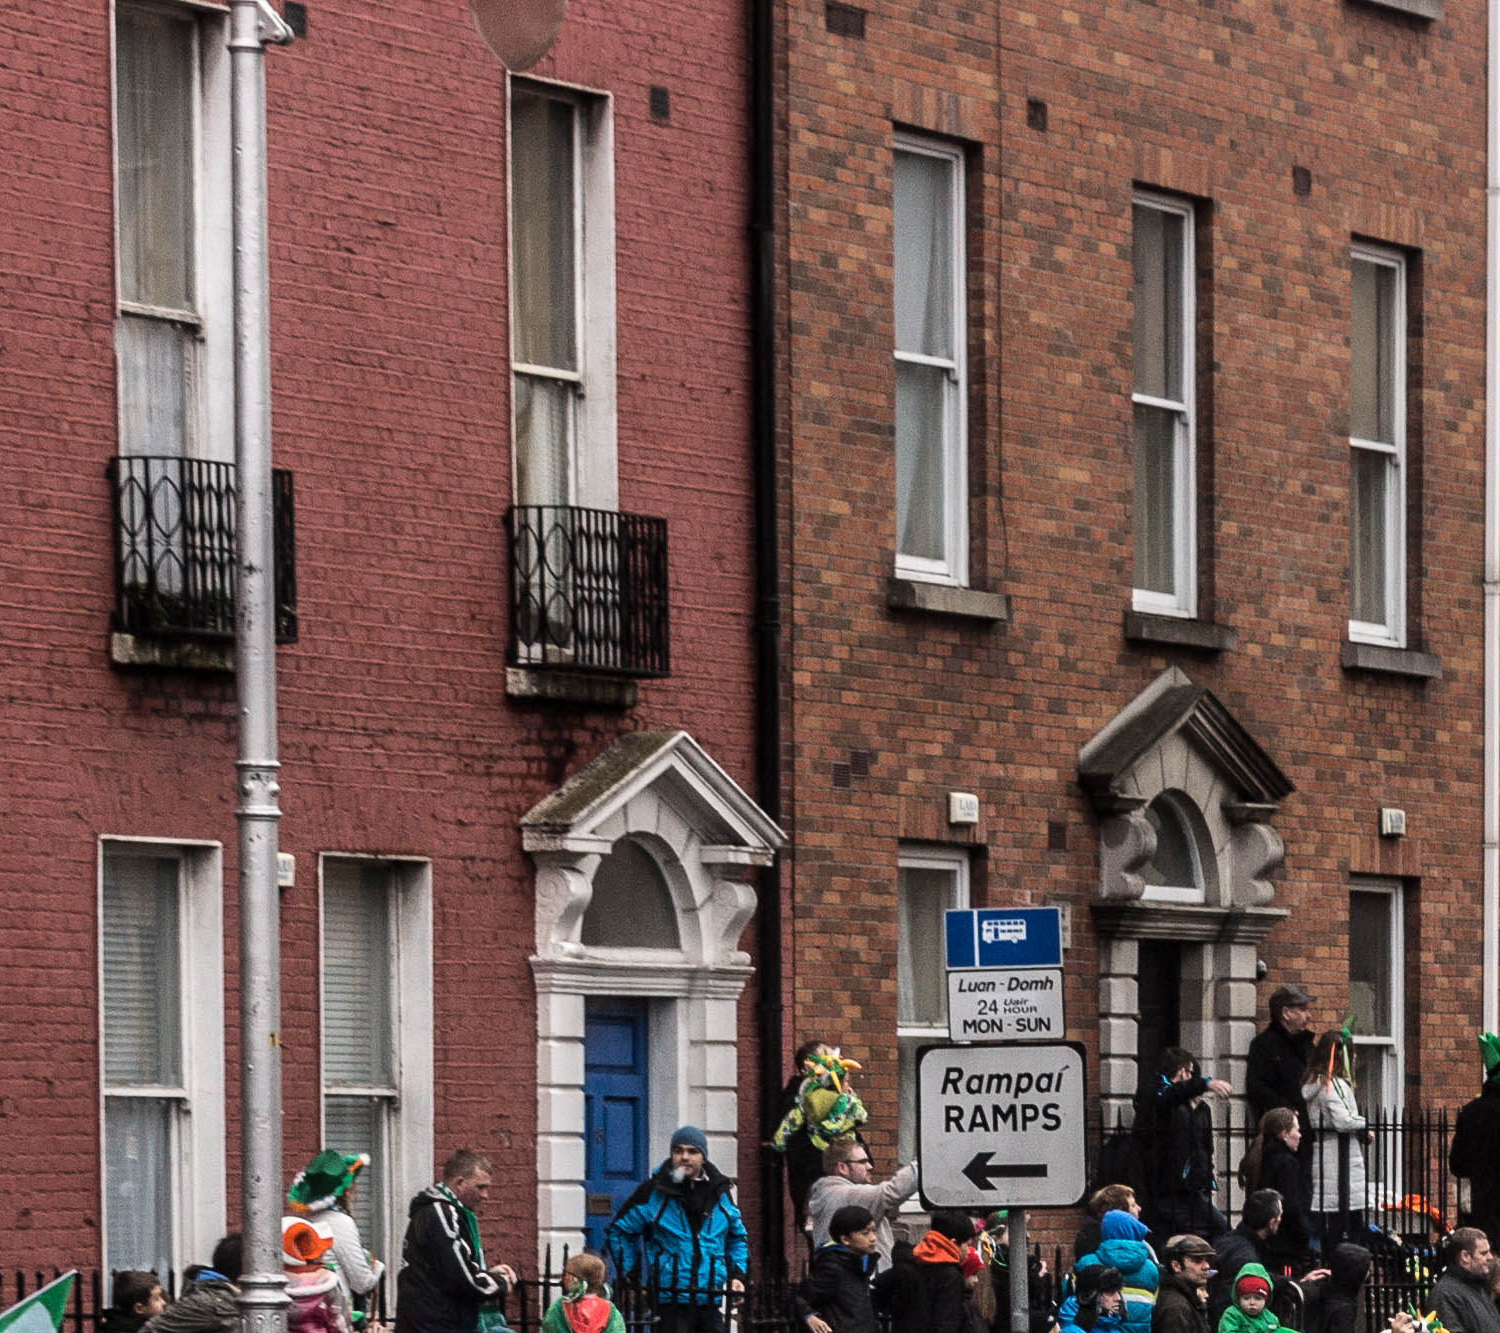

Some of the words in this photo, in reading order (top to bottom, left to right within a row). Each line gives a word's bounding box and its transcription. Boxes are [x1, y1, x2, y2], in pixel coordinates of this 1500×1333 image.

[958, 978, 996, 994] Luan
[1007, 977, 1054, 993] Domh
[977, 1000, 999, 1016] 24
[1002, 1005, 1038, 1014] HOUR
[963, 1019, 1003, 1034] MON
[1016, 1017, 1051, 1033] SUN
[940, 1065, 1070, 1100] Rampaí
[944, 1102, 1062, 1133] RAMPS
